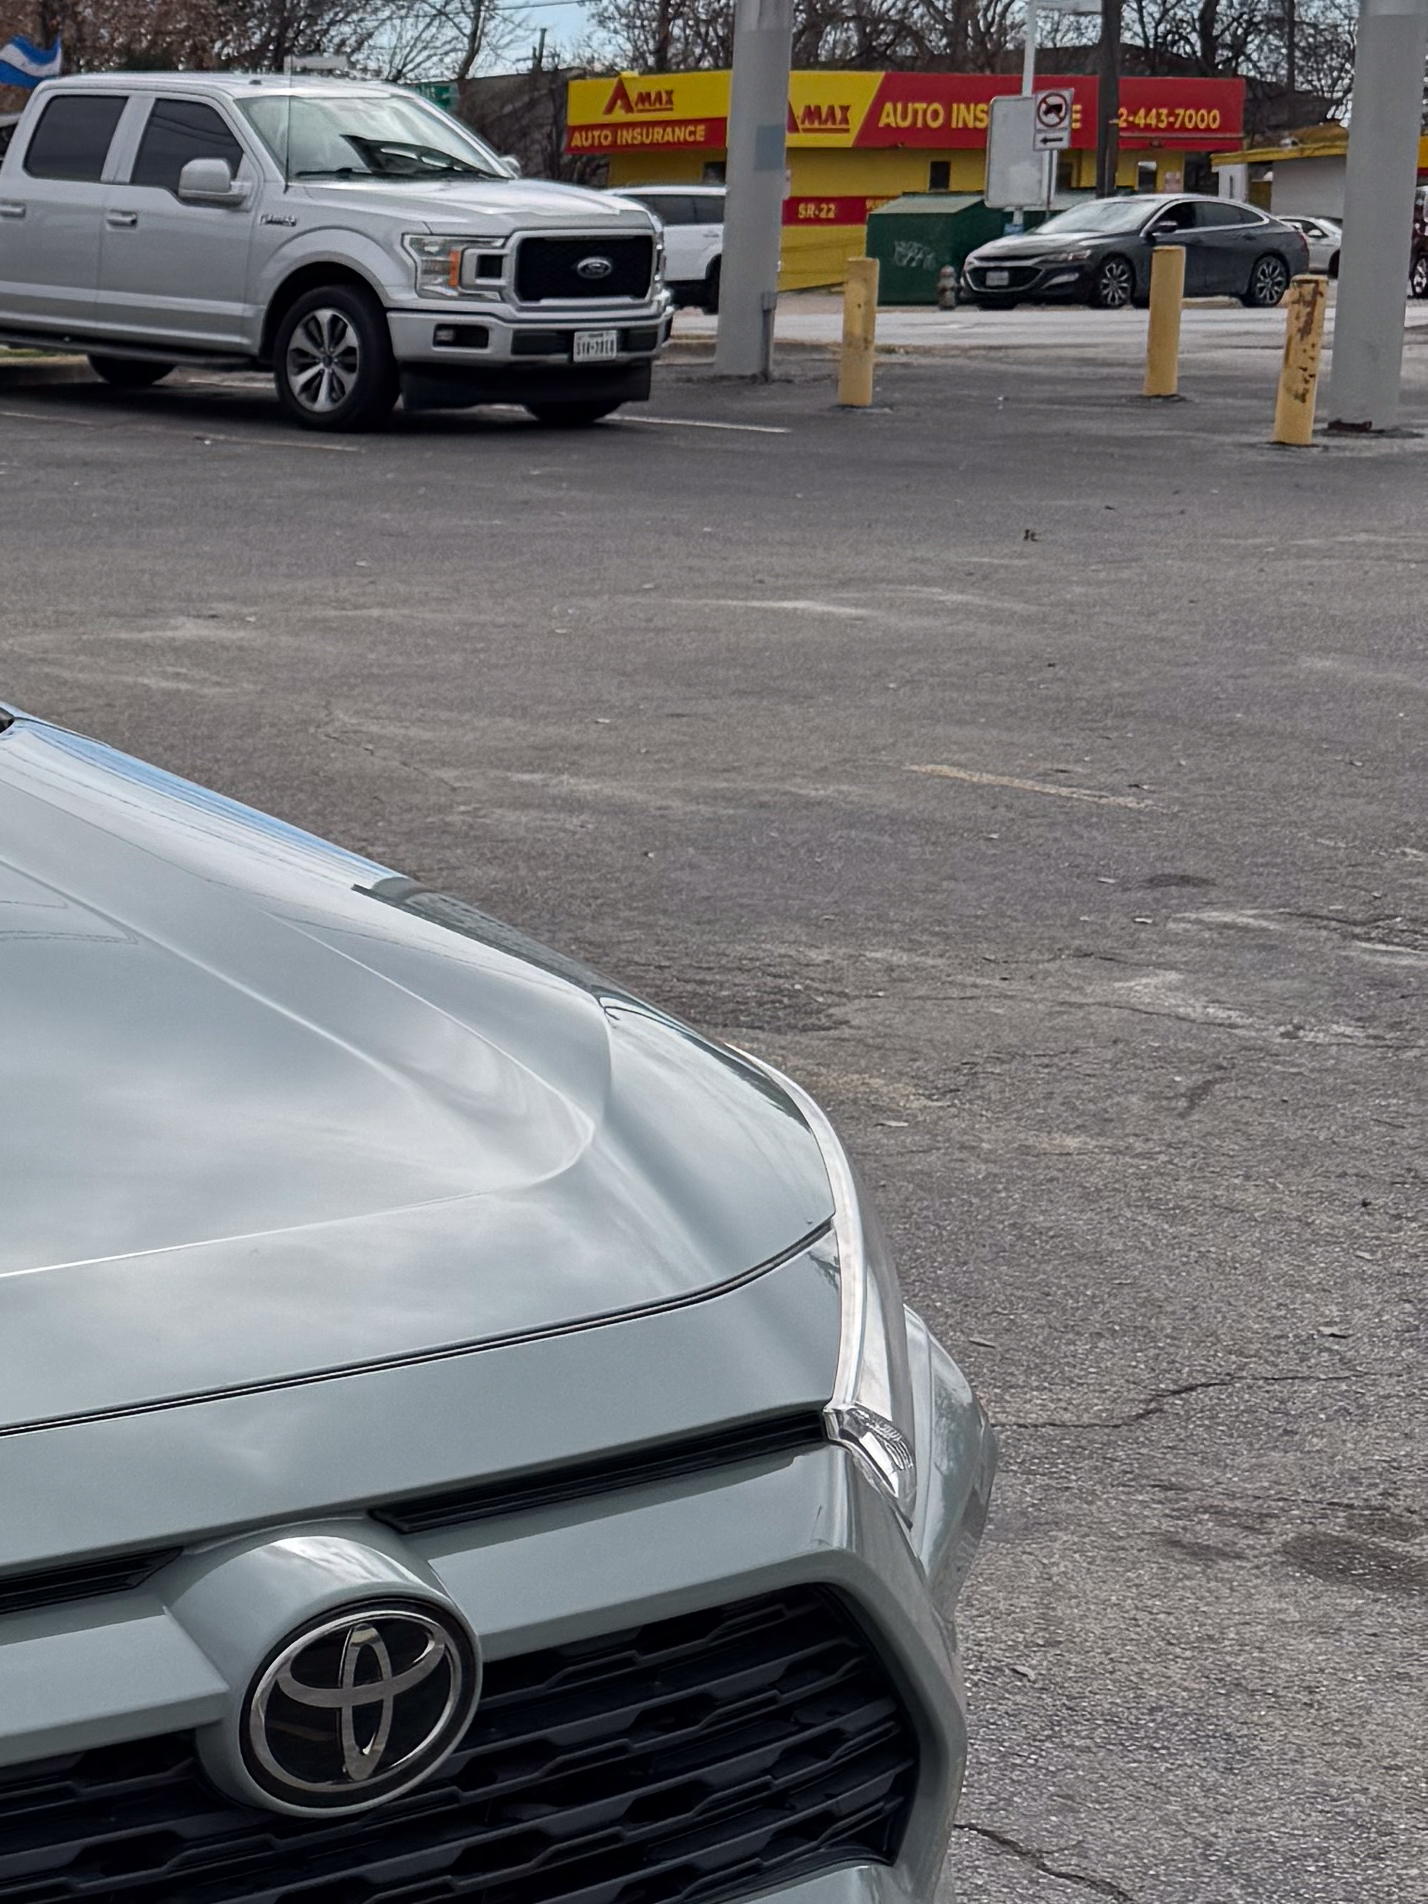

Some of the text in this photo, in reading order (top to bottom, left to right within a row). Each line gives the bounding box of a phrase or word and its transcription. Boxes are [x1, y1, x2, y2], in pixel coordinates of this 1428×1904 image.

[878, 101, 945, 129] AUTO
[1118, 106, 1222, 130] 2-443-7000
[570, 124, 706, 149] AUTO INSURANCE
